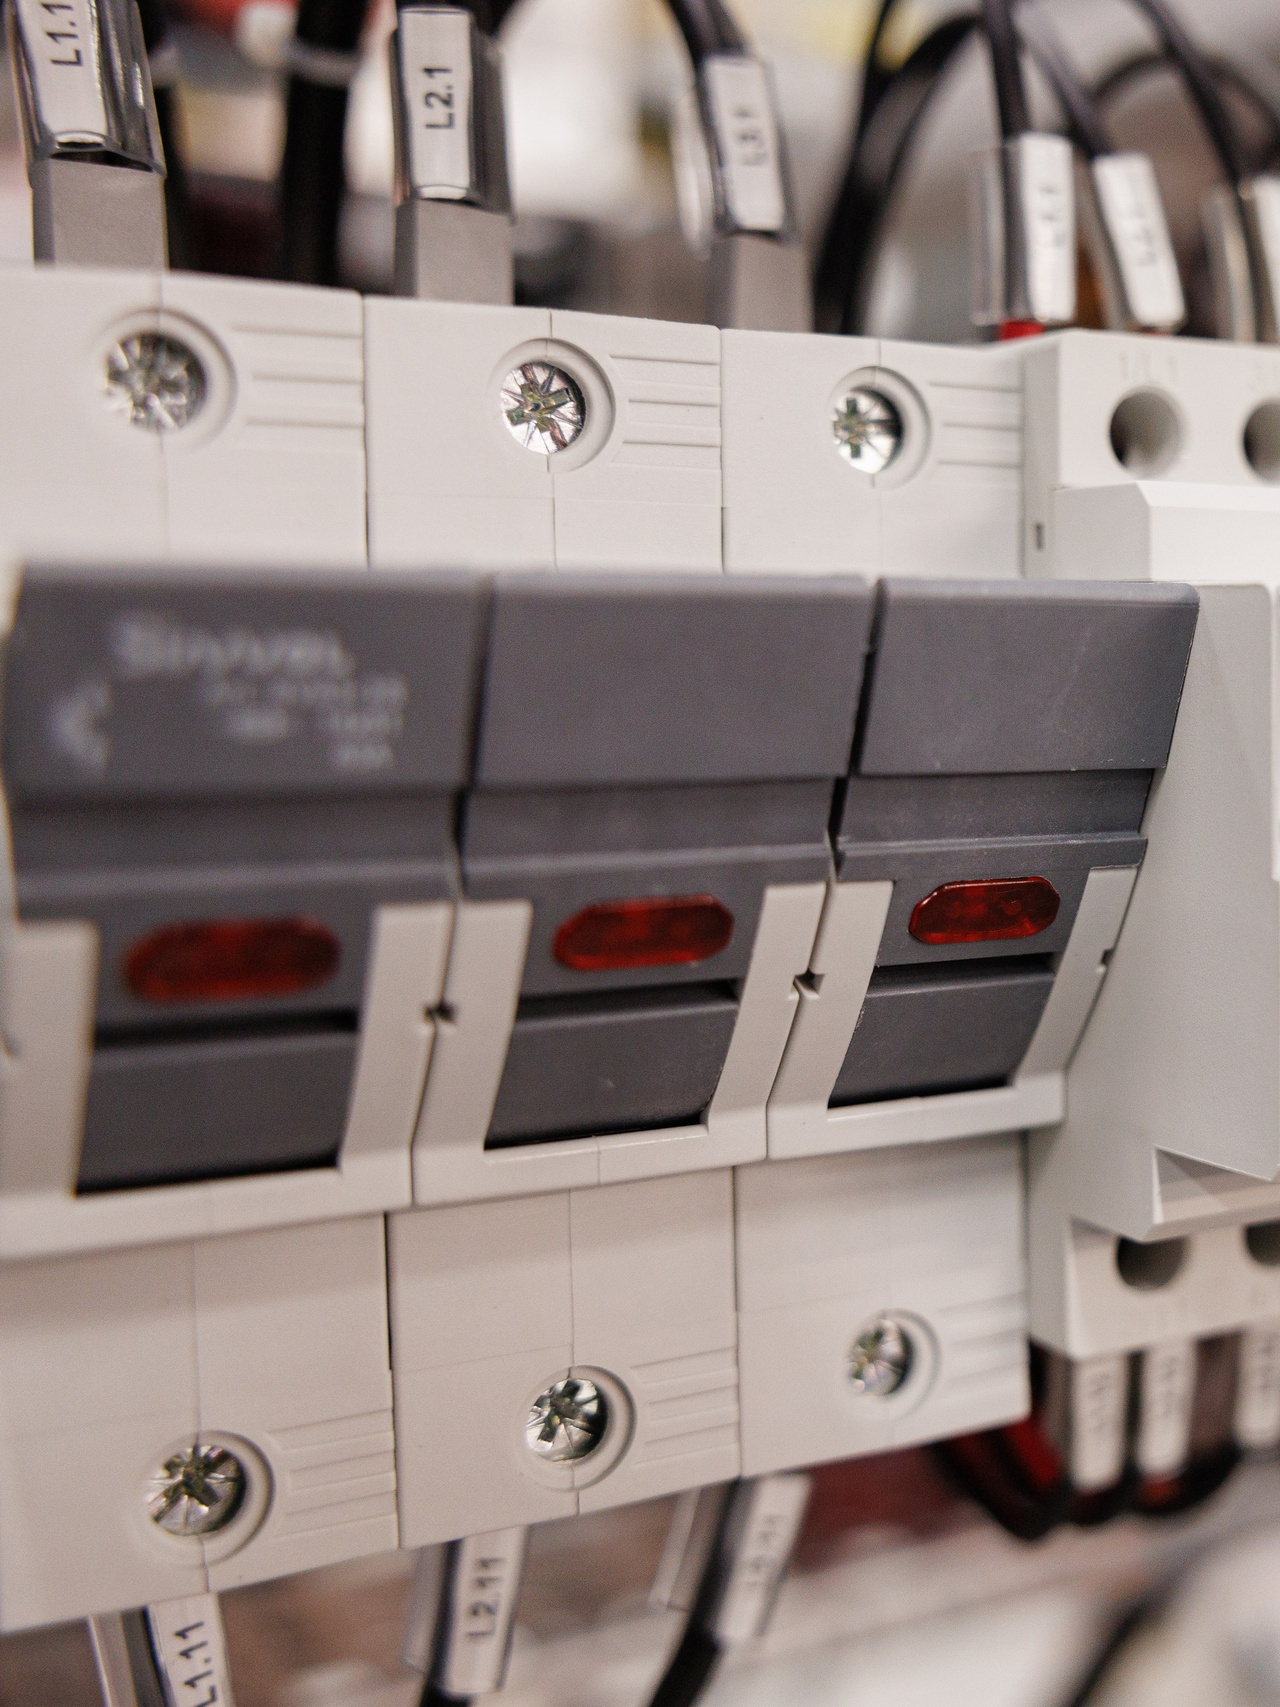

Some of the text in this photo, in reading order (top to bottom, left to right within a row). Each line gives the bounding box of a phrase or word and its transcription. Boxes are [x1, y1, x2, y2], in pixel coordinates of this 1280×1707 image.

[41, 2, 83, 67] L1.1
[421, 65, 455, 130] L2.1
[465, 1555, 506, 1640] L2.11
[174, 1620, 219, 1707] L1.11
